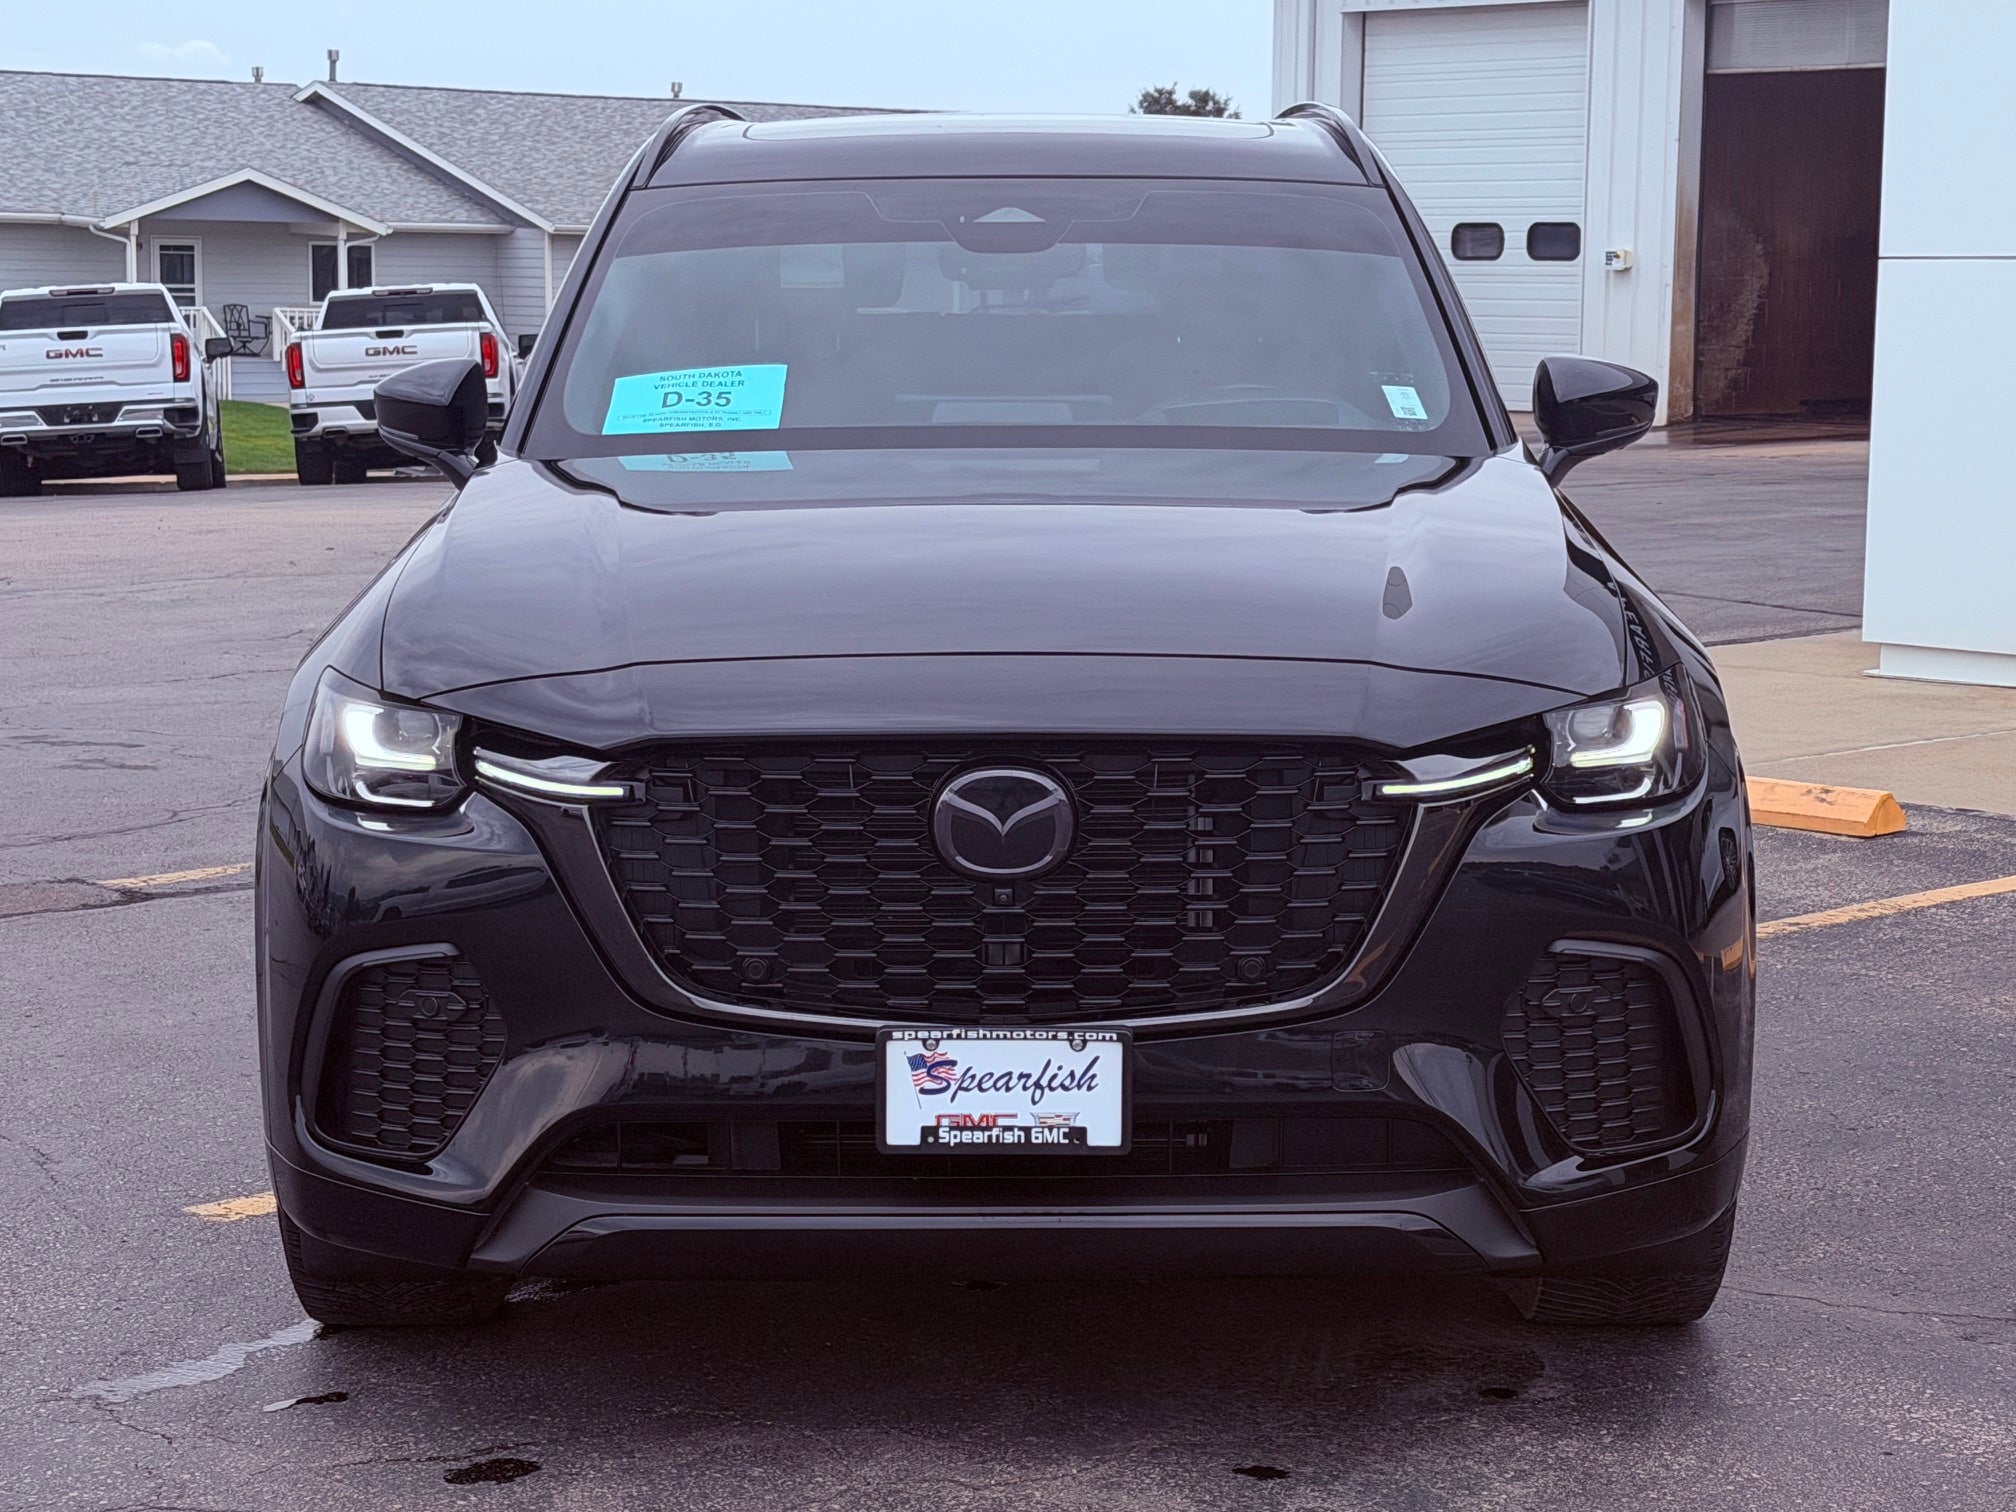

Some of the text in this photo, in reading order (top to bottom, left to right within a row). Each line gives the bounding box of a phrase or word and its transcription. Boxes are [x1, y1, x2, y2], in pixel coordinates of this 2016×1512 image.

[46, 347, 103, 359] GMC
[365, 345, 418, 357] GMC
[659, 370, 743, 382] SOUTH DAKOTA
[654, 380, 745, 390] VEHICLE DEALER
[661, 391, 732, 409] D-35
[892, 1028, 1118, 1041] spearfishmotors.com
[918, 1055, 1101, 1106] Spearfish
[935, 1113, 1018, 1127] GMC
[938, 1127, 1070, 1147] Spearfish GMC
